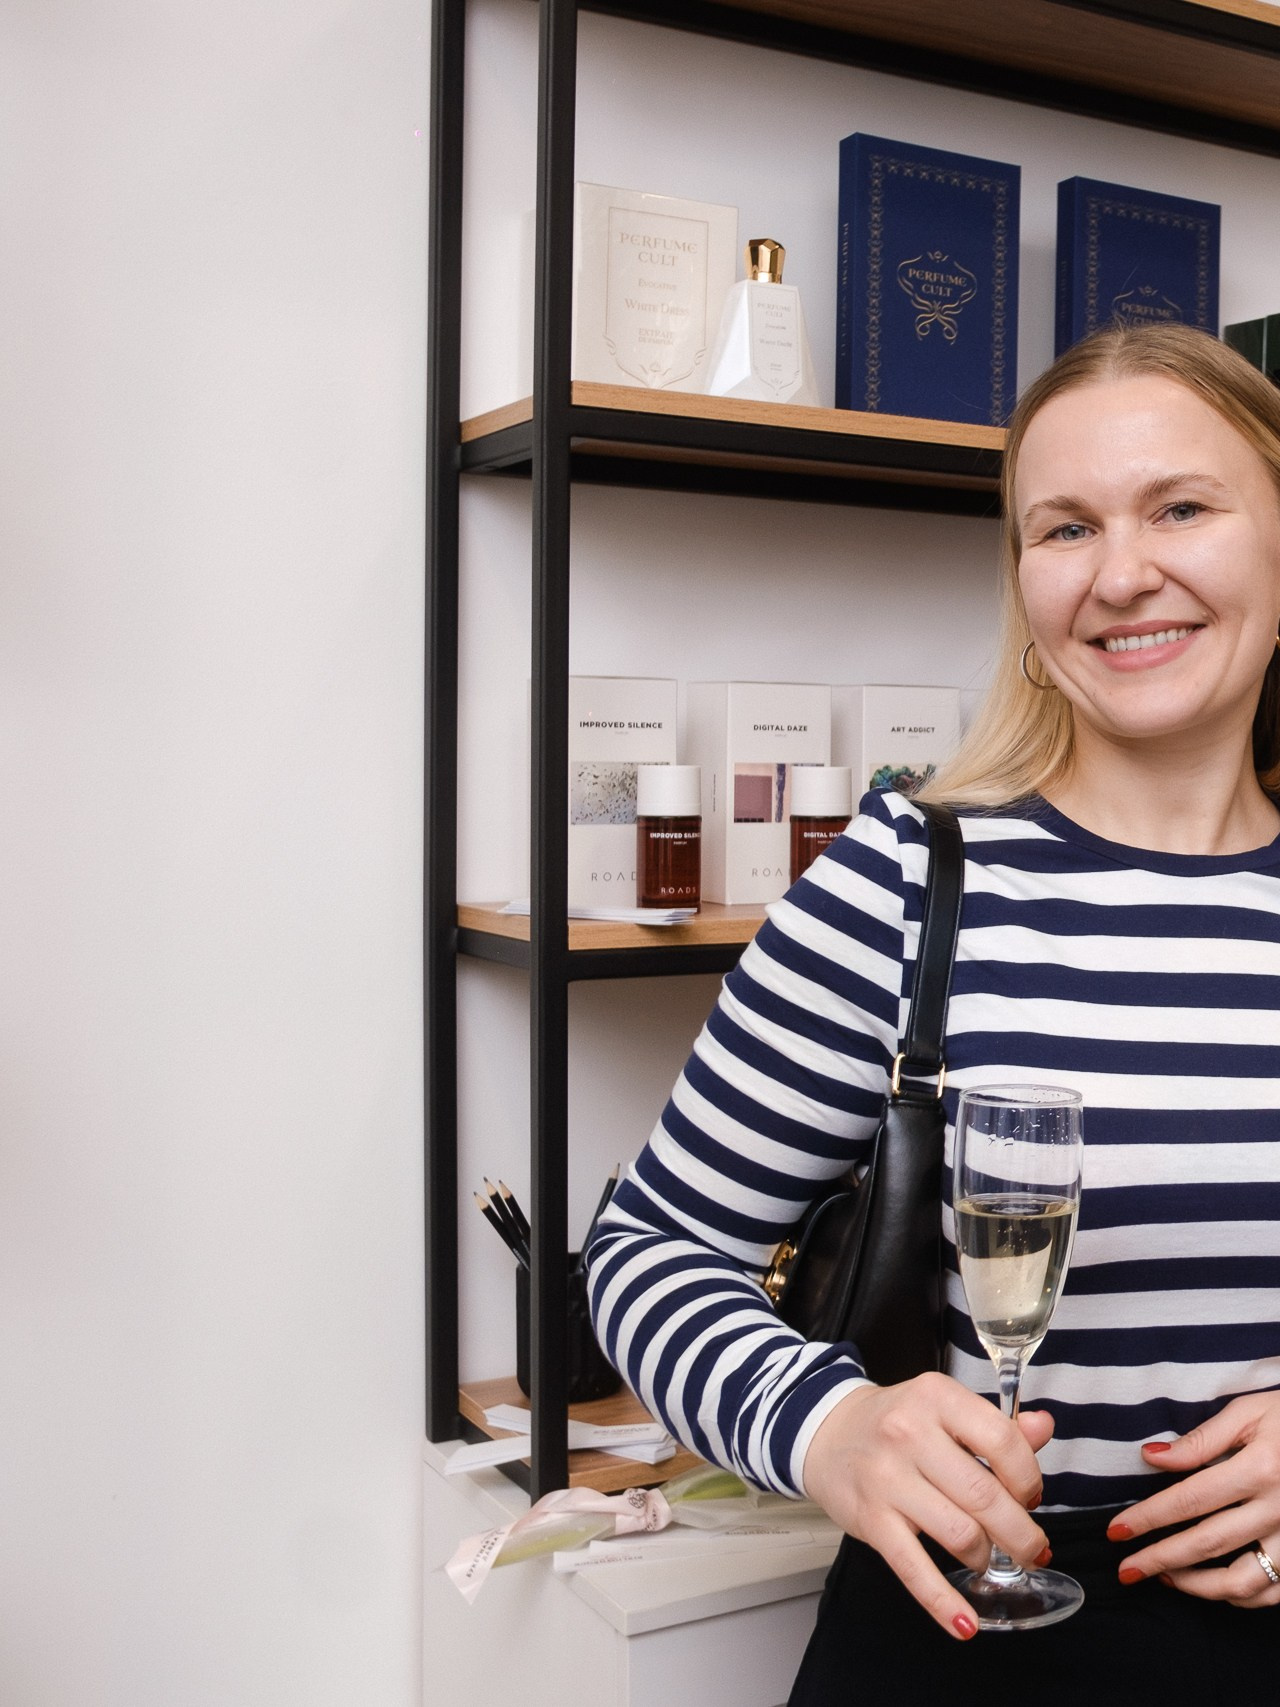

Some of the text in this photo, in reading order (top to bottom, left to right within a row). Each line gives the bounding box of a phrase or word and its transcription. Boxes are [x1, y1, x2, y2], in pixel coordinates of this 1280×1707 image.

[619, 231, 698, 254] PERFUME
[638, 251, 677, 266] CULT
[908, 268, 967, 287] PERFUME
[921, 284, 952, 297] CULT
[579, 721, 625, 729] IMPROVED
[660, 886, 697, 895] ROADS
